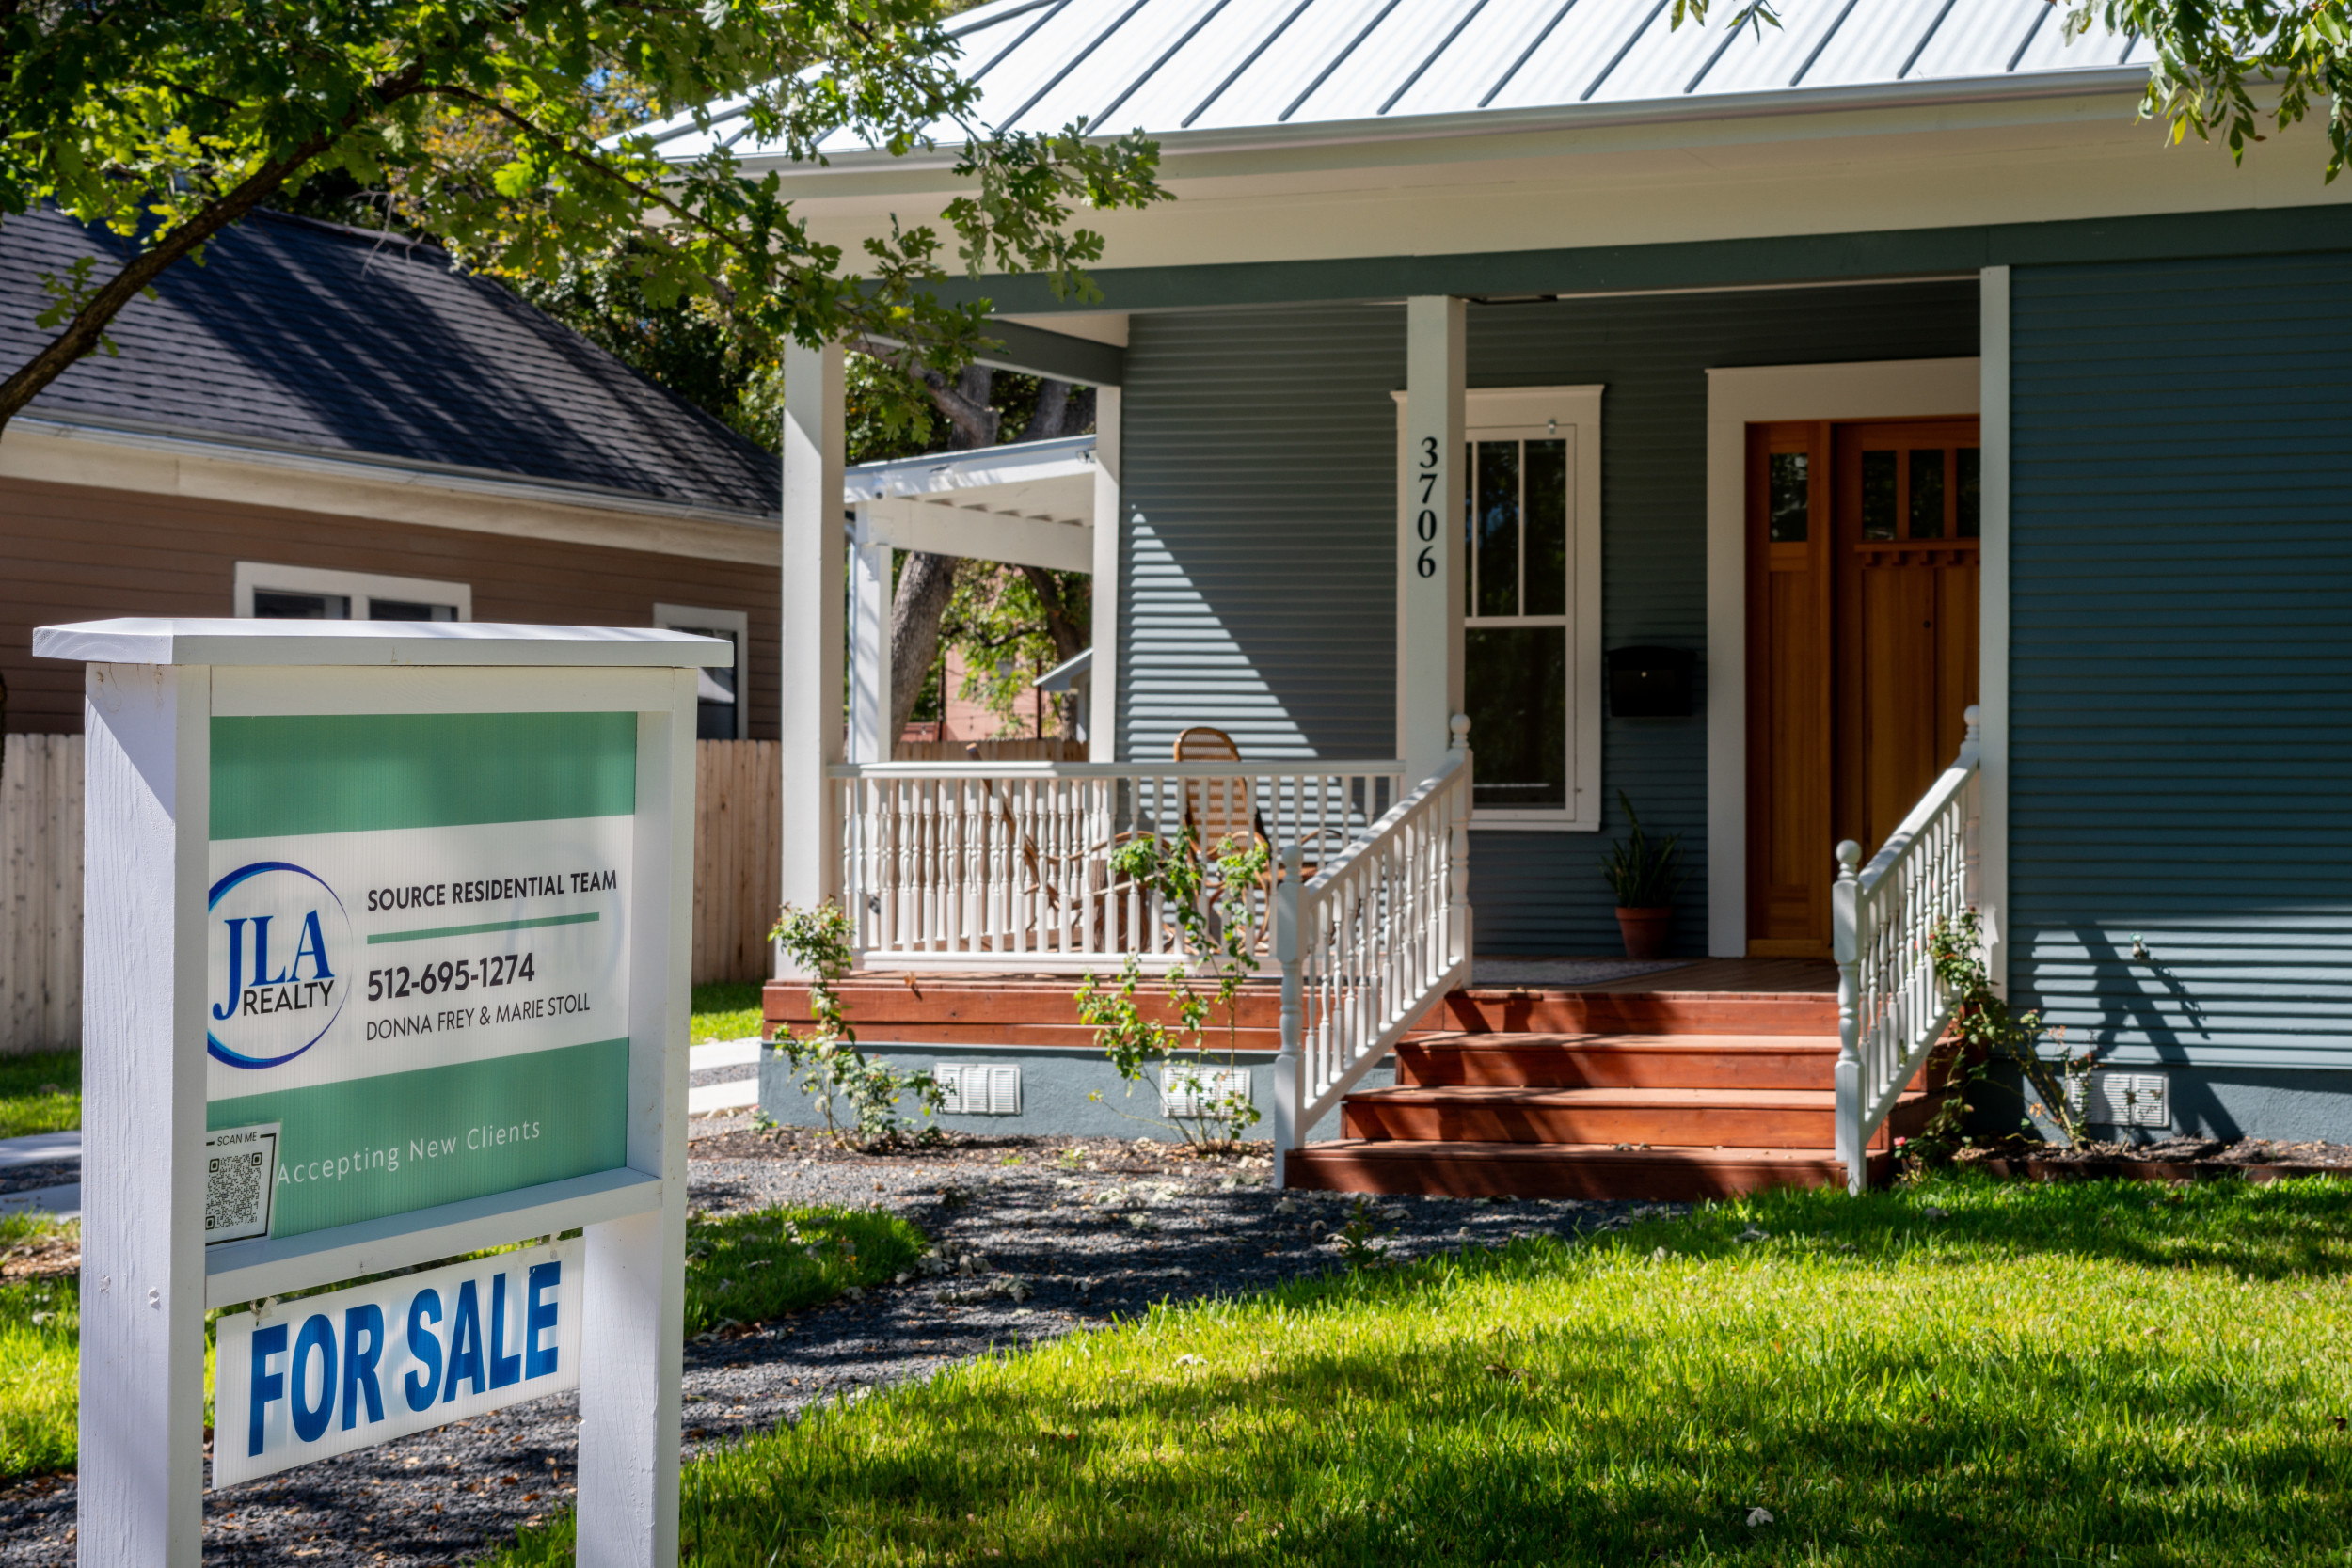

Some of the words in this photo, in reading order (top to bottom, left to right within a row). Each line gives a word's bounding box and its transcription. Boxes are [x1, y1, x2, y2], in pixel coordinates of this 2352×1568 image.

[1417, 436, 1438, 578] 3706
[367, 883, 446, 911] SOURCE
[453, 876, 565, 905] RESIDENTIAL
[570, 869, 617, 894] TEAM
[212, 909, 335, 1021] JLA
[367, 952, 535, 1002] 512-695-1274
[243, 980, 335, 1017] REALTY
[366, 1014, 433, 1040] DONNA
[437, 1007, 473, 1032] FREY
[479, 1005, 491, 1025] &
[495, 999, 544, 1023] MARIE
[548, 992, 590, 1015] STOLL
[216, 1133, 243, 1147] SCAN
[245, 1132, 257, 1143] ME
[277, 1145, 400, 1186] Accepting
[410, 1136, 456, 1162] New
[467, 1120, 541, 1150] Clients
[248, 1303, 385, 1457] FOR
[405, 1260, 562, 1412] SALE
